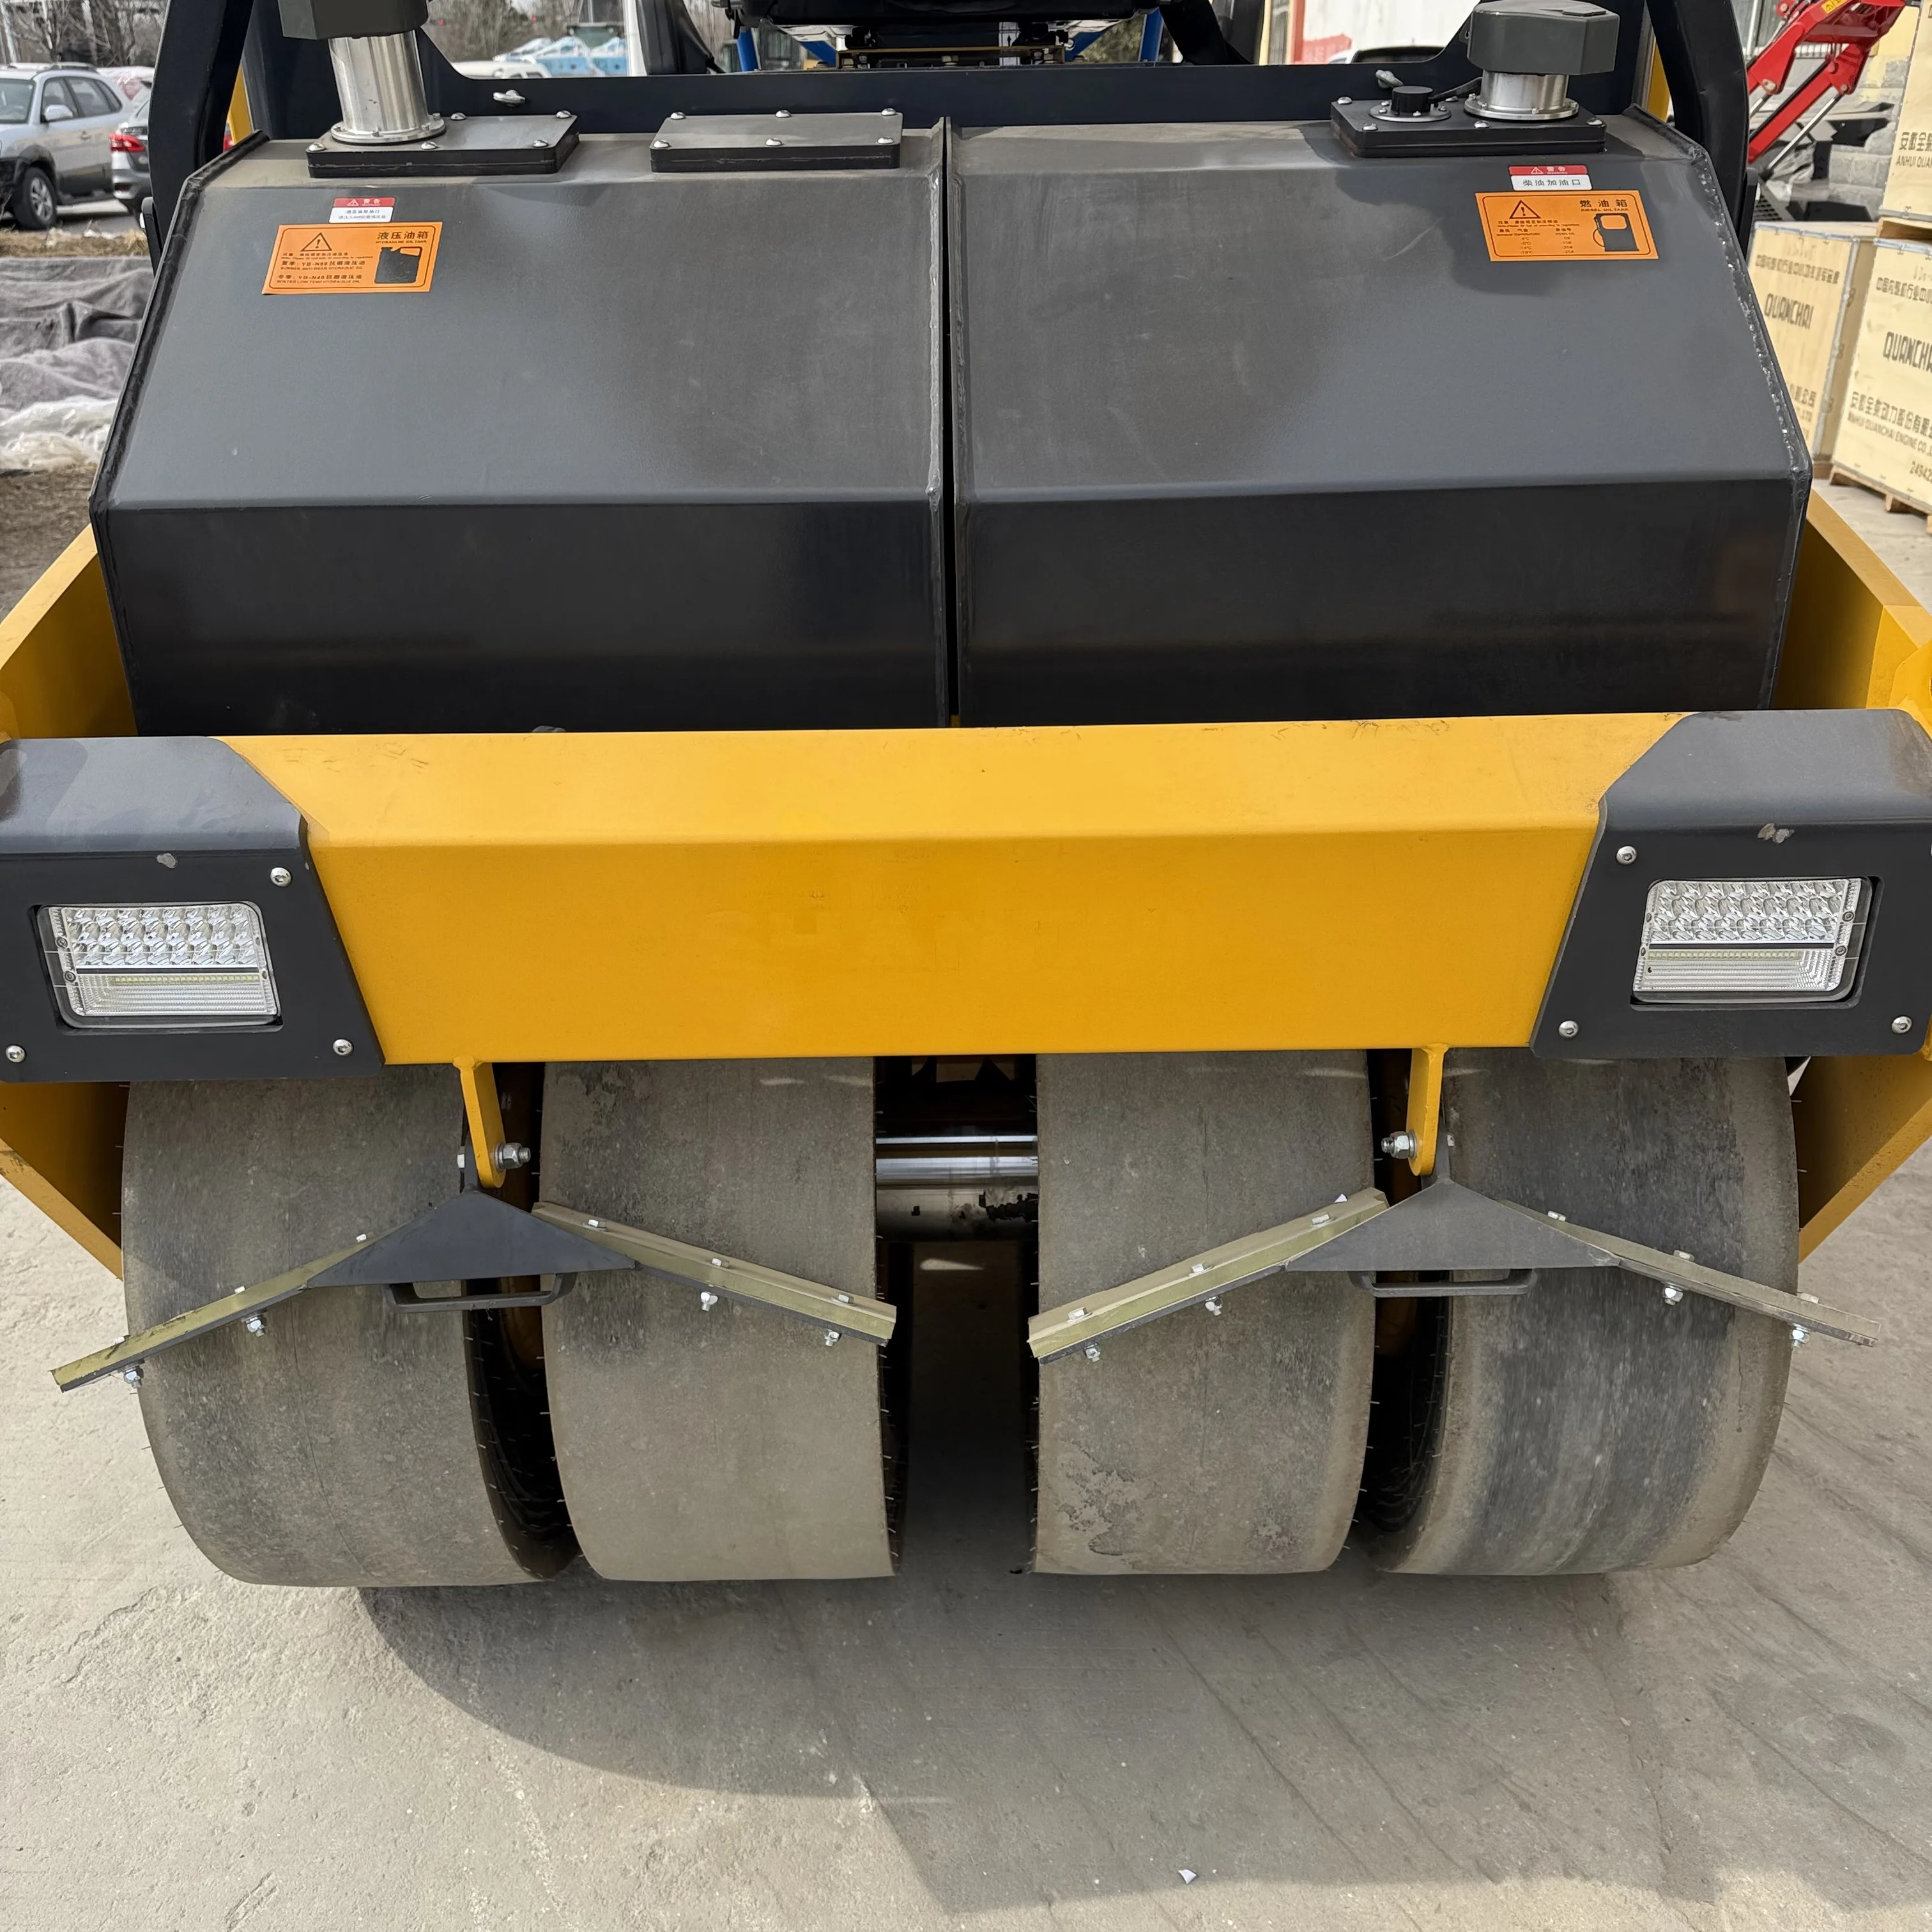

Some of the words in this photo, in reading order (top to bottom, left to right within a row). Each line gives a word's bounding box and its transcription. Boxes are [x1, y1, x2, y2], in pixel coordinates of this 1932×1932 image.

[1579, 199, 1628, 208] 燃油箱
[377, 231, 429, 240] 液压油箱
